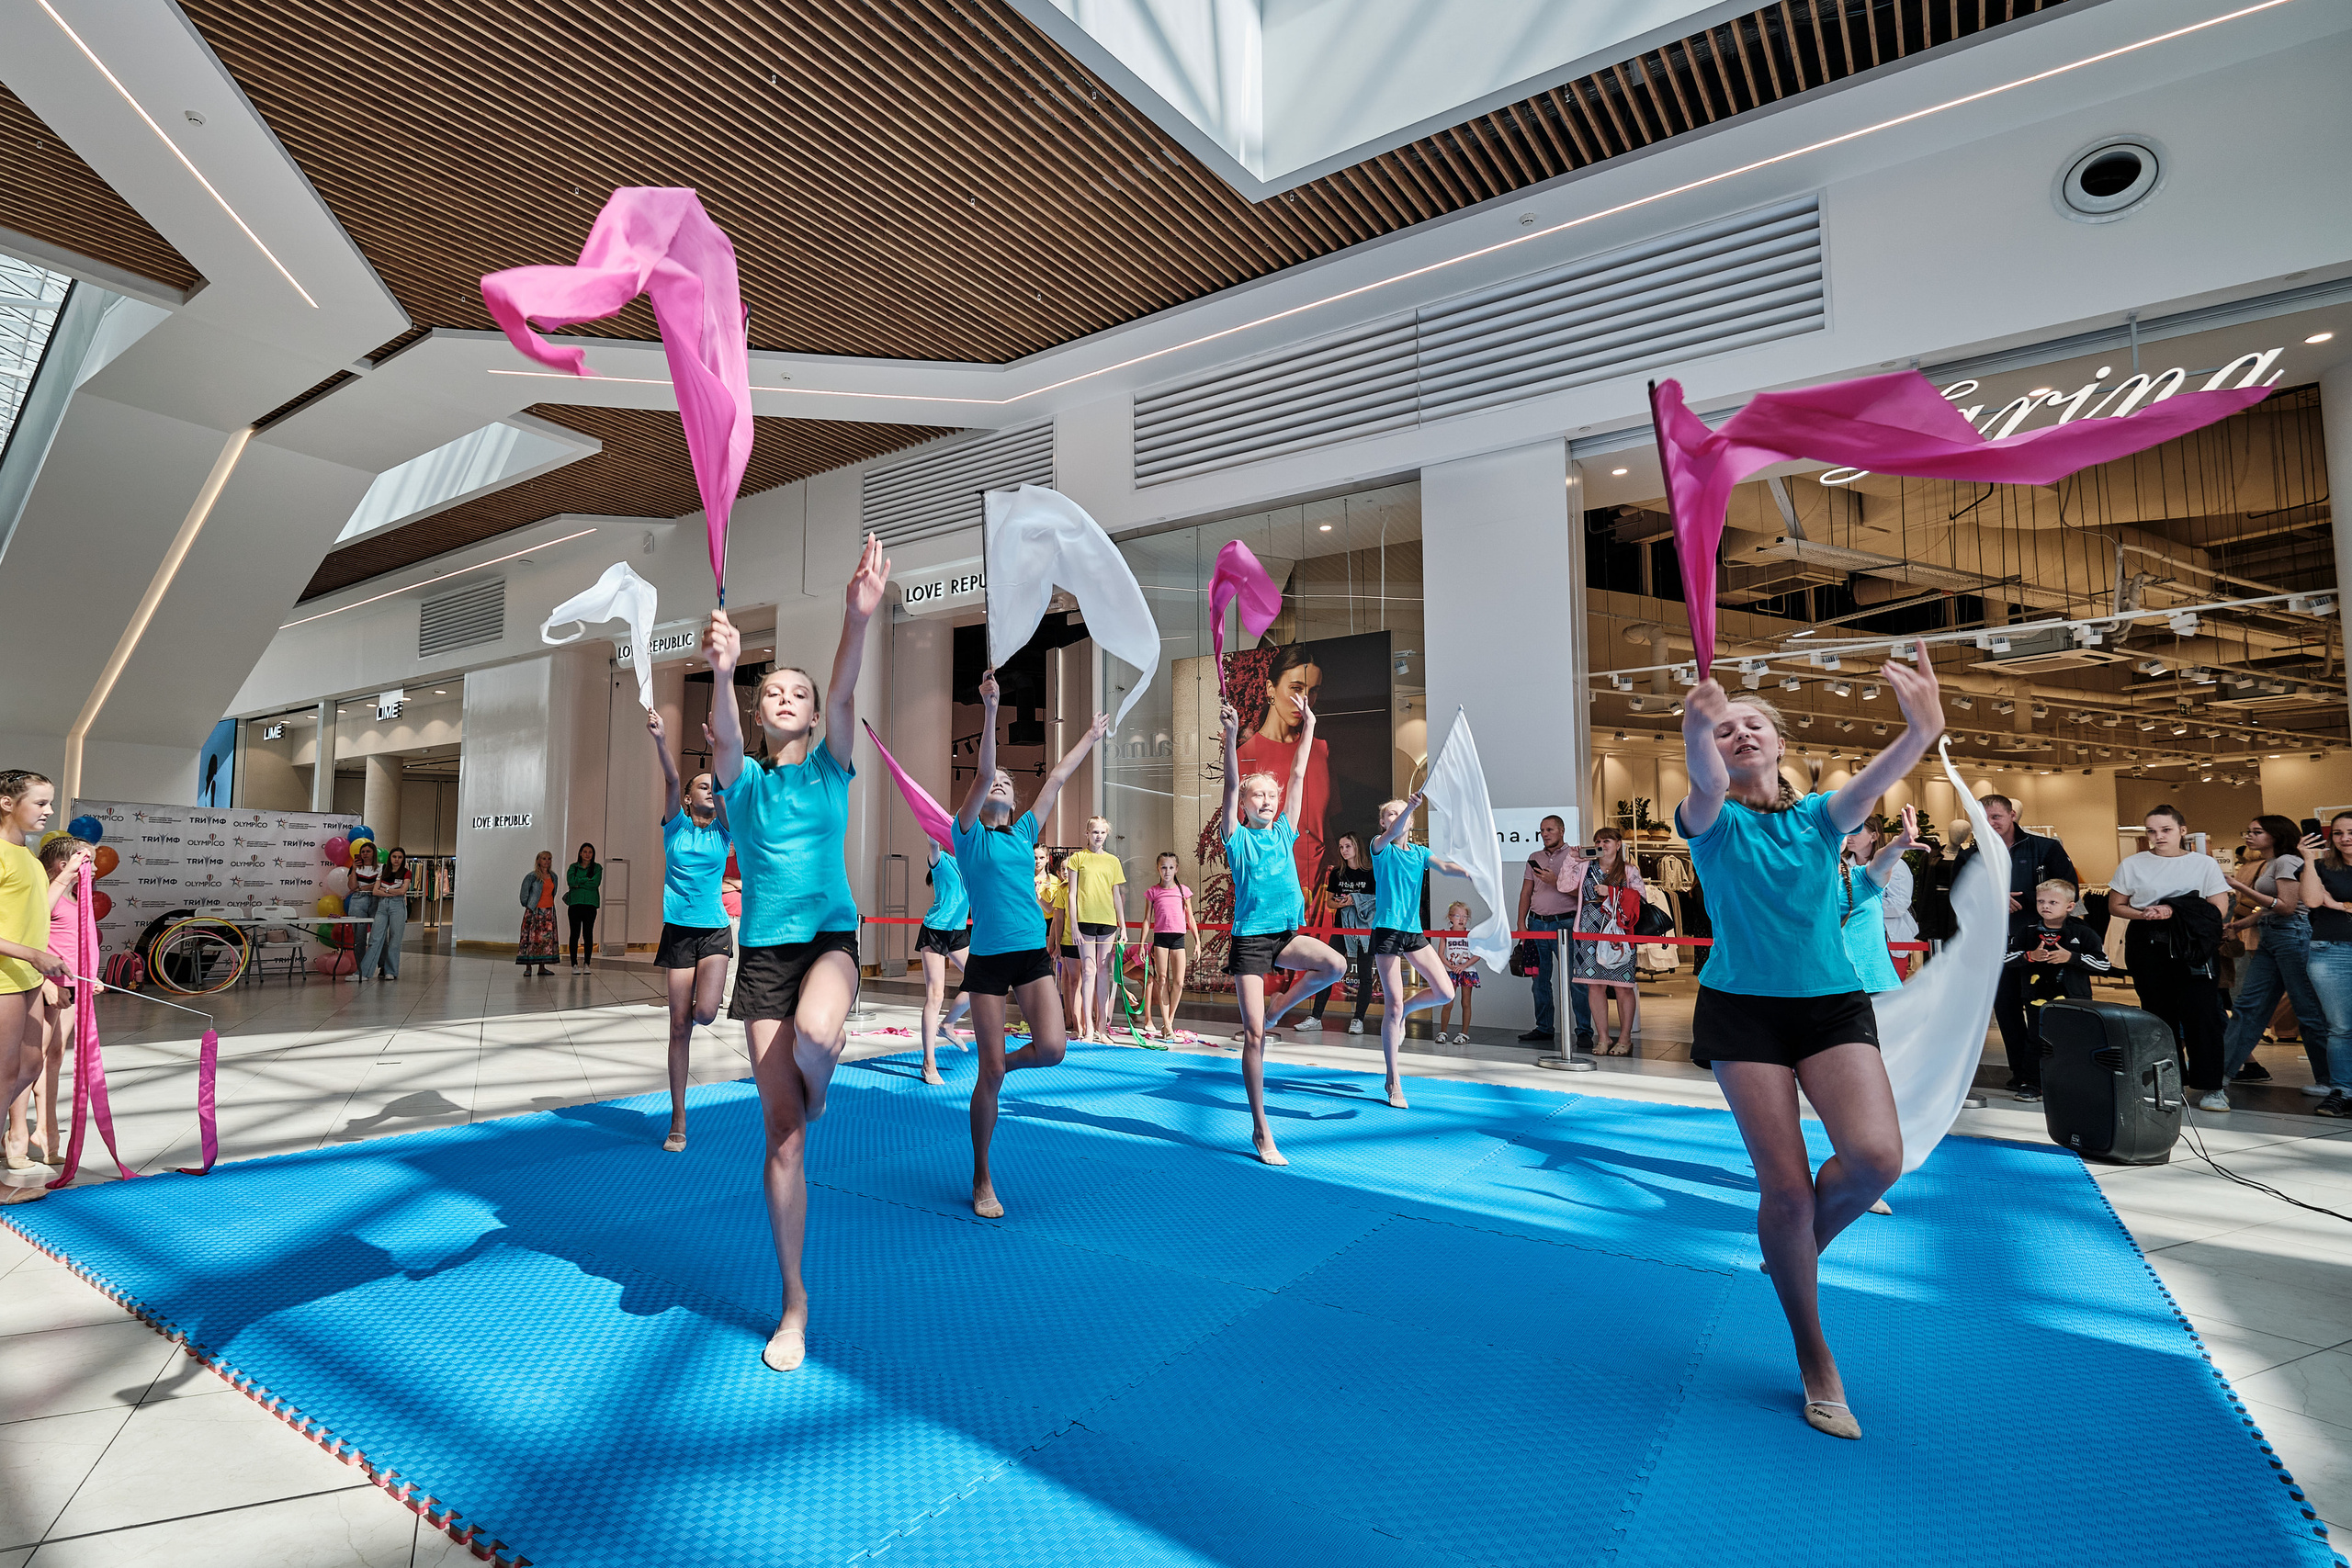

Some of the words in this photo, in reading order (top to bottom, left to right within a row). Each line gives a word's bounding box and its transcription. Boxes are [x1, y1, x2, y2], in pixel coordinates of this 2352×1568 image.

[906, 582, 942, 603] LOVE
[951, 573, 986, 594] REPU
[472, 817, 492, 829] LOVE
[494, 814, 531, 827] REPUBLIC
